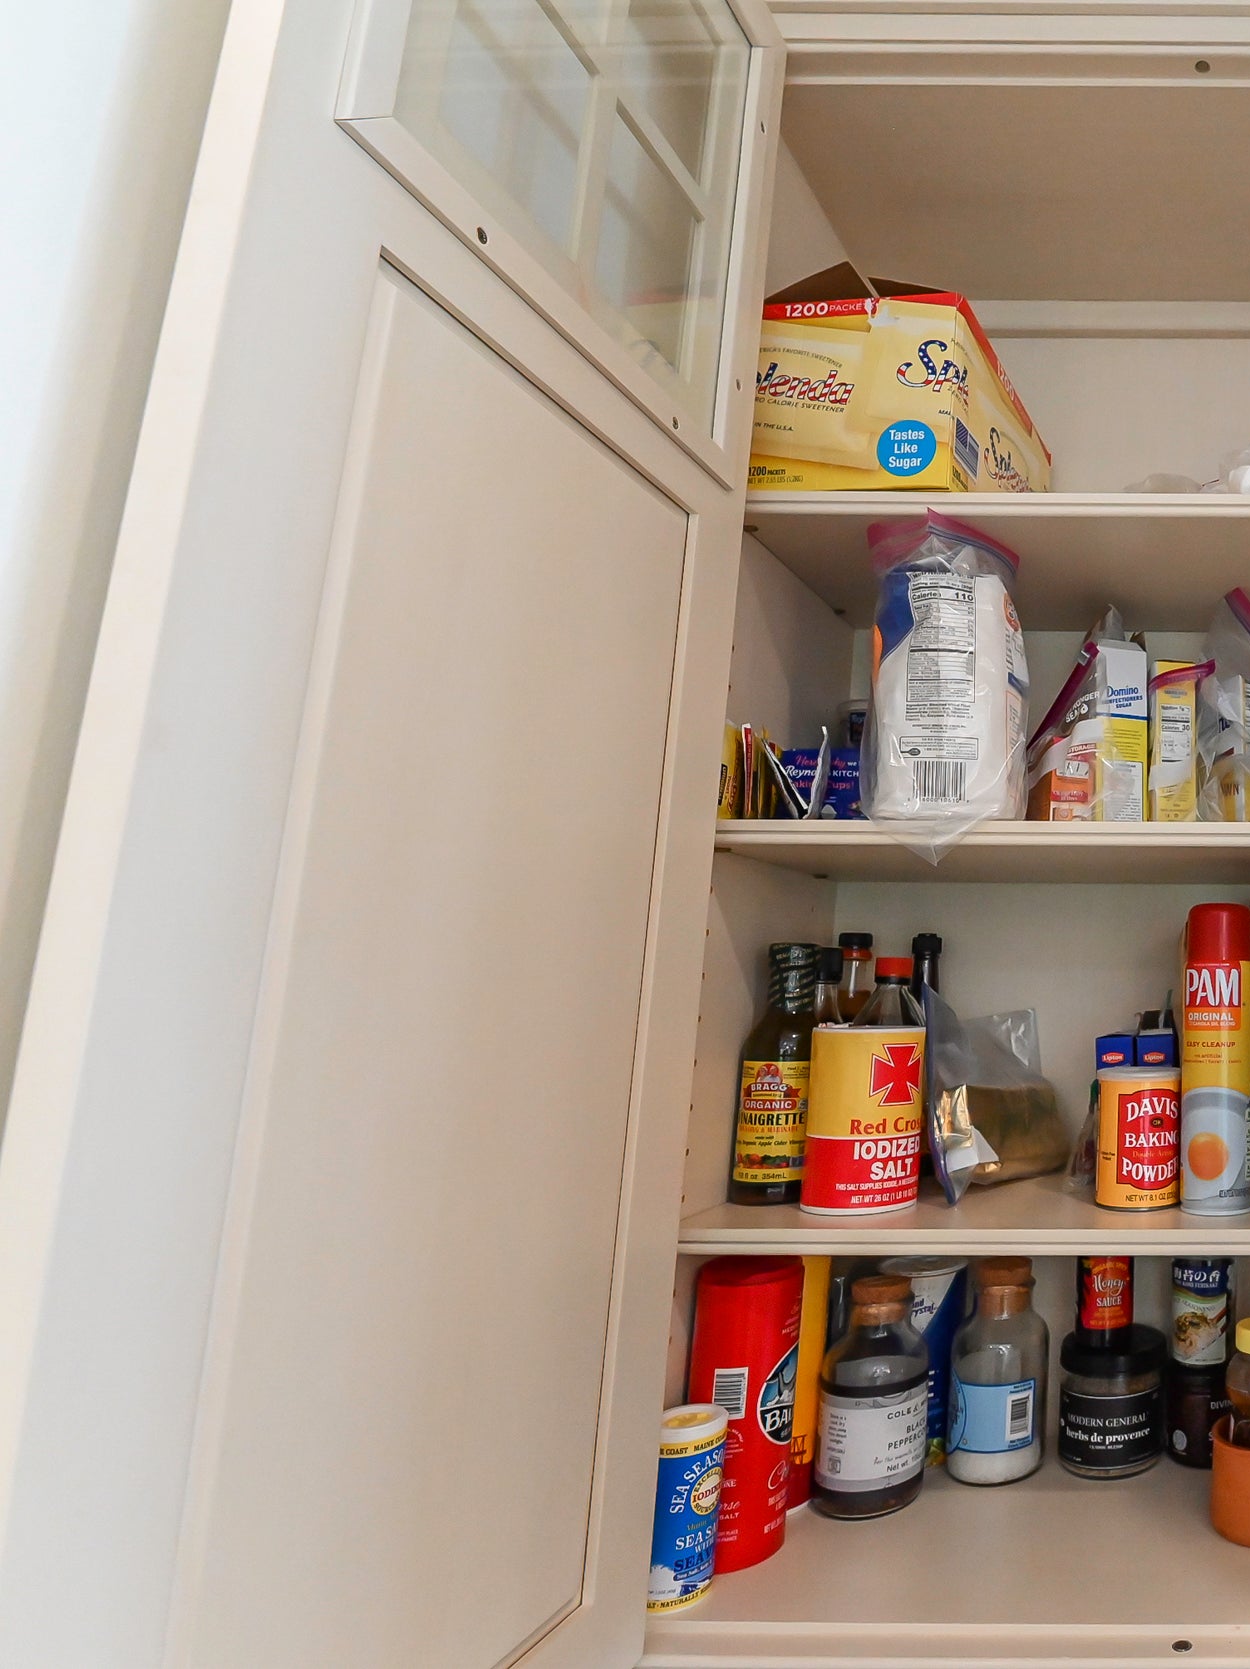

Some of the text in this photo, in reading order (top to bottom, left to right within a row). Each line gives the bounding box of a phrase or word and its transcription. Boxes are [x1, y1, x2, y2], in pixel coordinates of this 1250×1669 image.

[785, 302, 870, 317] 1200 PACKE
[756, 362, 855, 406] lenda
[767, 398, 845, 414] CALORIE SWEETENER
[889, 429, 926, 441] Tastes
[894, 443, 918, 454] Like
[888, 457, 923, 470] Sugar
[748, 466, 767, 476] 1200
[955, 592, 974, 601] 110
[1107, 685, 1139, 697] Domino
[832, 769, 859, 777] KITCH
[1186, 968, 1239, 1006] PAM
[1188, 1012, 1234, 1021] ORIGINAL
[1103, 1054, 1123, 1062] Lipton
[1144, 1054, 1164, 1062] Lipton
[751, 1083, 788, 1091] BRAGG
[744, 1100, 792, 1109] ORGANIC
[1126, 1097, 1179, 1122] DAVIS
[740, 1112, 805, 1126] INAIGRETTE
[850, 1117, 921, 1135] Red Cros
[853, 1136, 920, 1160] IODIZED
[870, 1158, 913, 1180] SALT
[836, 1183, 846, 1191] THIS
[847, 1183, 859, 1191] SALT
[860, 1182, 882, 1190] SUPPLIES
[851, 1196, 863, 1204] NET
[864, 1195, 874, 1203] WT
[882, 1193, 889, 1202] OZ
[1092, 1274, 1124, 1296] Honey
[1096, 1296, 1122, 1307] SAUCE
[887, 1407, 911, 1420] COLE
[1067, 1412, 1146, 1427] MODERN GENERAL
[1066, 1426, 1150, 1445] herbs de provence
[666, 1439, 715, 1455] COAST MAINE
[887, 1463, 899, 1472] Net
[669, 1485, 690, 1514] SEA
[675, 1531, 703, 1550] SEA
[660, 1591, 699, 1609] NATURALLY
